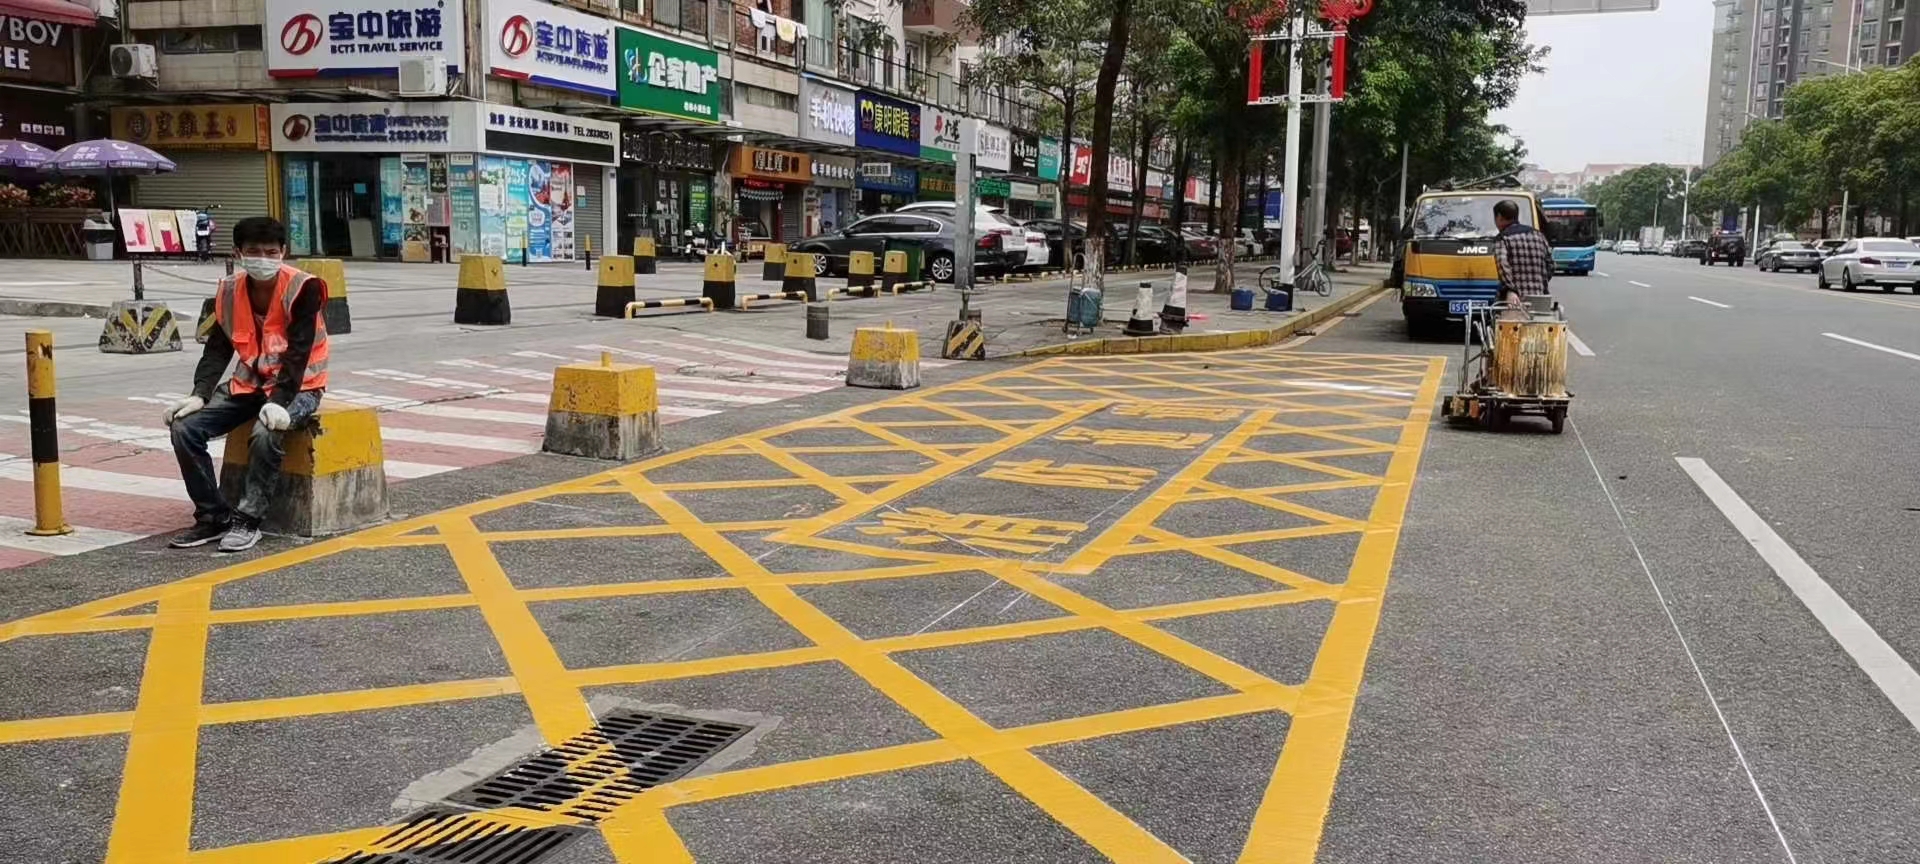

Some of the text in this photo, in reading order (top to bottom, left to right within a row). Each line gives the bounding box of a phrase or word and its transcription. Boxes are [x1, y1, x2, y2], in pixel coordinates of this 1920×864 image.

[328, 8, 442, 42] 宝中旅游
[330, 40, 443, 54] BCTS TRAVEL SERVICE
[535, 20, 608, 60] 宝中旅游
[314, 114, 387, 133] 宝中旅游
[873, 103, 911, 139] 康明眼镜
[573, 126, 585, 137] TEL
[1457, 246, 1489, 254] JMC
